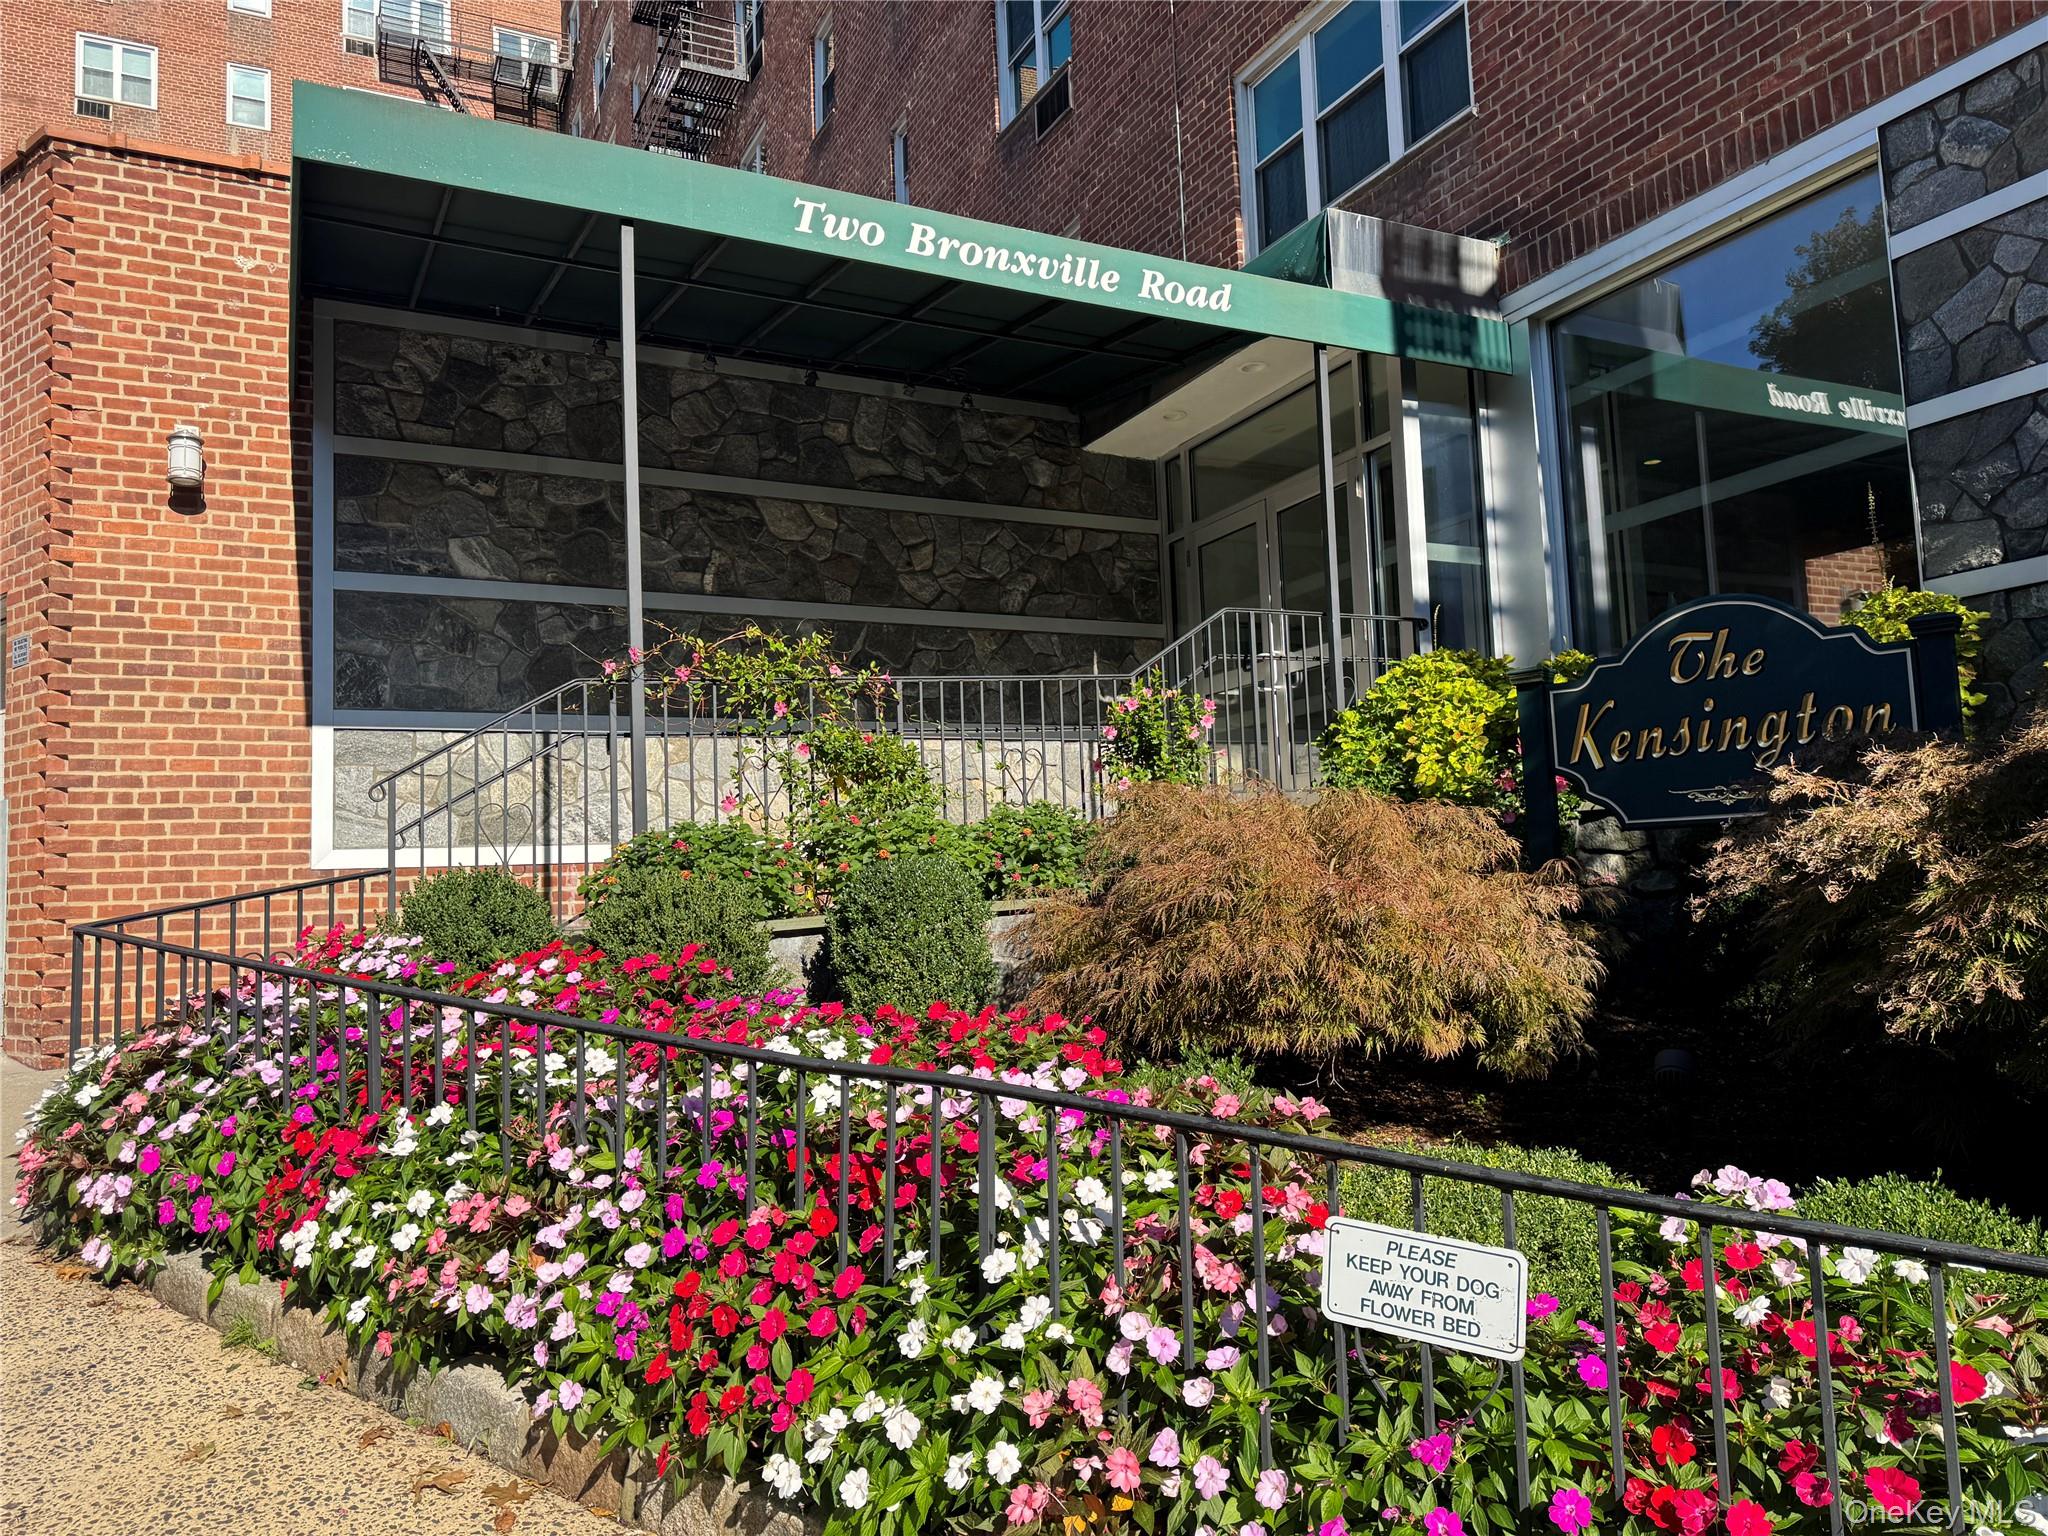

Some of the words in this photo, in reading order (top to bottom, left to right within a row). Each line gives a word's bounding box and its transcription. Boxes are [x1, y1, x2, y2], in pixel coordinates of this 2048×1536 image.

[793, 197, 885, 247] Two
[905, 222, 1121, 292] Bronxville
[1138, 268, 1233, 312] Road
[1668, 628, 1765, 685] The
[1570, 691, 1897, 769] Kensington
[1346, 1253, 1392, 1276] KEEP
[1400, 1264, 1449, 1289] YOUR
[1456, 1276, 1500, 1300] DOG
[1386, 1241, 1458, 1269] PLEASE
[1360, 1298, 1436, 1329] FLOWER
[1443, 1315, 1481, 1338] BED
[1368, 1279, 1414, 1302] AWAY
[1421, 1290, 1475, 1316] FROM
